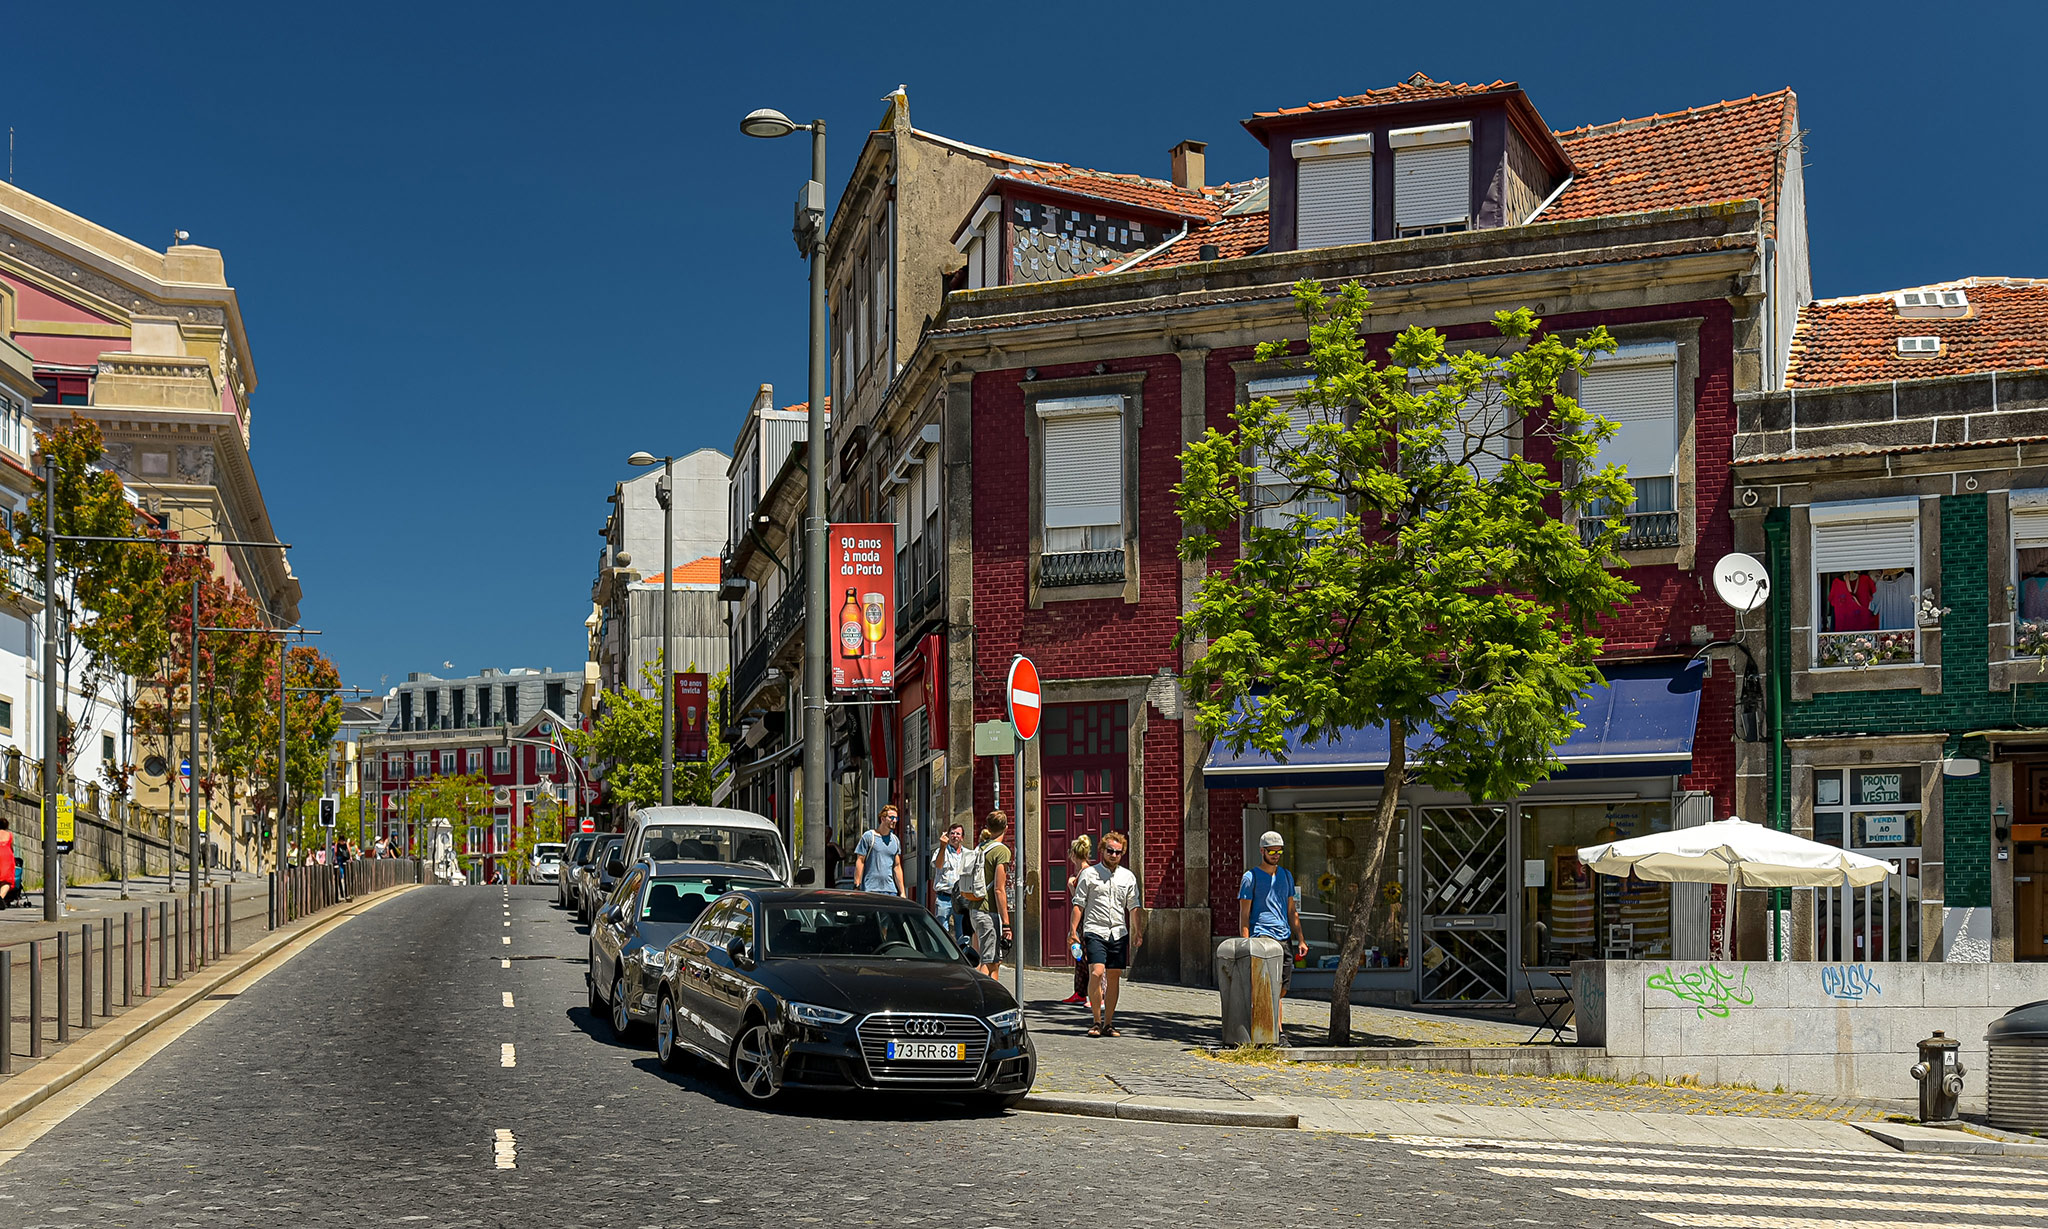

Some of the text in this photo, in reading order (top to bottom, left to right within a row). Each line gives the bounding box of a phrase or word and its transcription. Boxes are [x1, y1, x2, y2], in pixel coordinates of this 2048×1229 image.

[841, 537, 882, 549] 90 anos
[843, 550, 880, 562] à moda
[841, 563, 883, 575] do Porto
[1725, 570, 1754, 586] NOS
[1863, 775, 1899, 786] PRONTO
[1863, 791, 1899, 802] VESTIR
[1869, 833, 1902, 841] PÚBLICO
